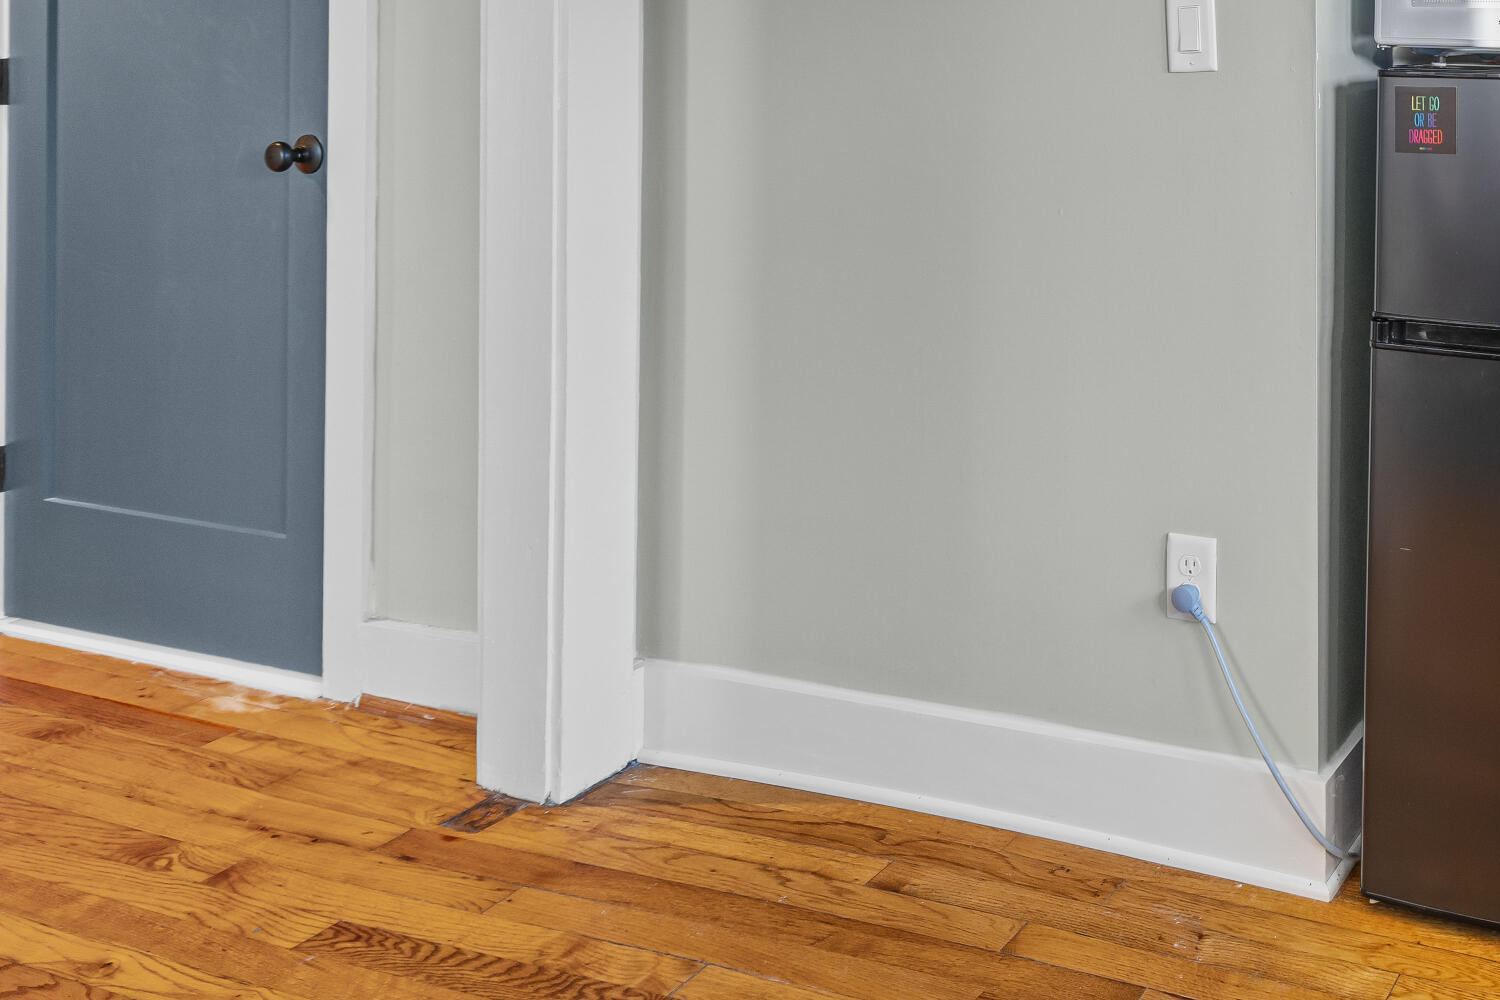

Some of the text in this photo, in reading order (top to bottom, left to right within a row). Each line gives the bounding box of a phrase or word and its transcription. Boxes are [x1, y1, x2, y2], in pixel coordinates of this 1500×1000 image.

[1411, 95, 1440, 111] LET GO
[1414, 112, 1438, 128] OR BE
[1408, 128, 1443, 145] DRAGGED
